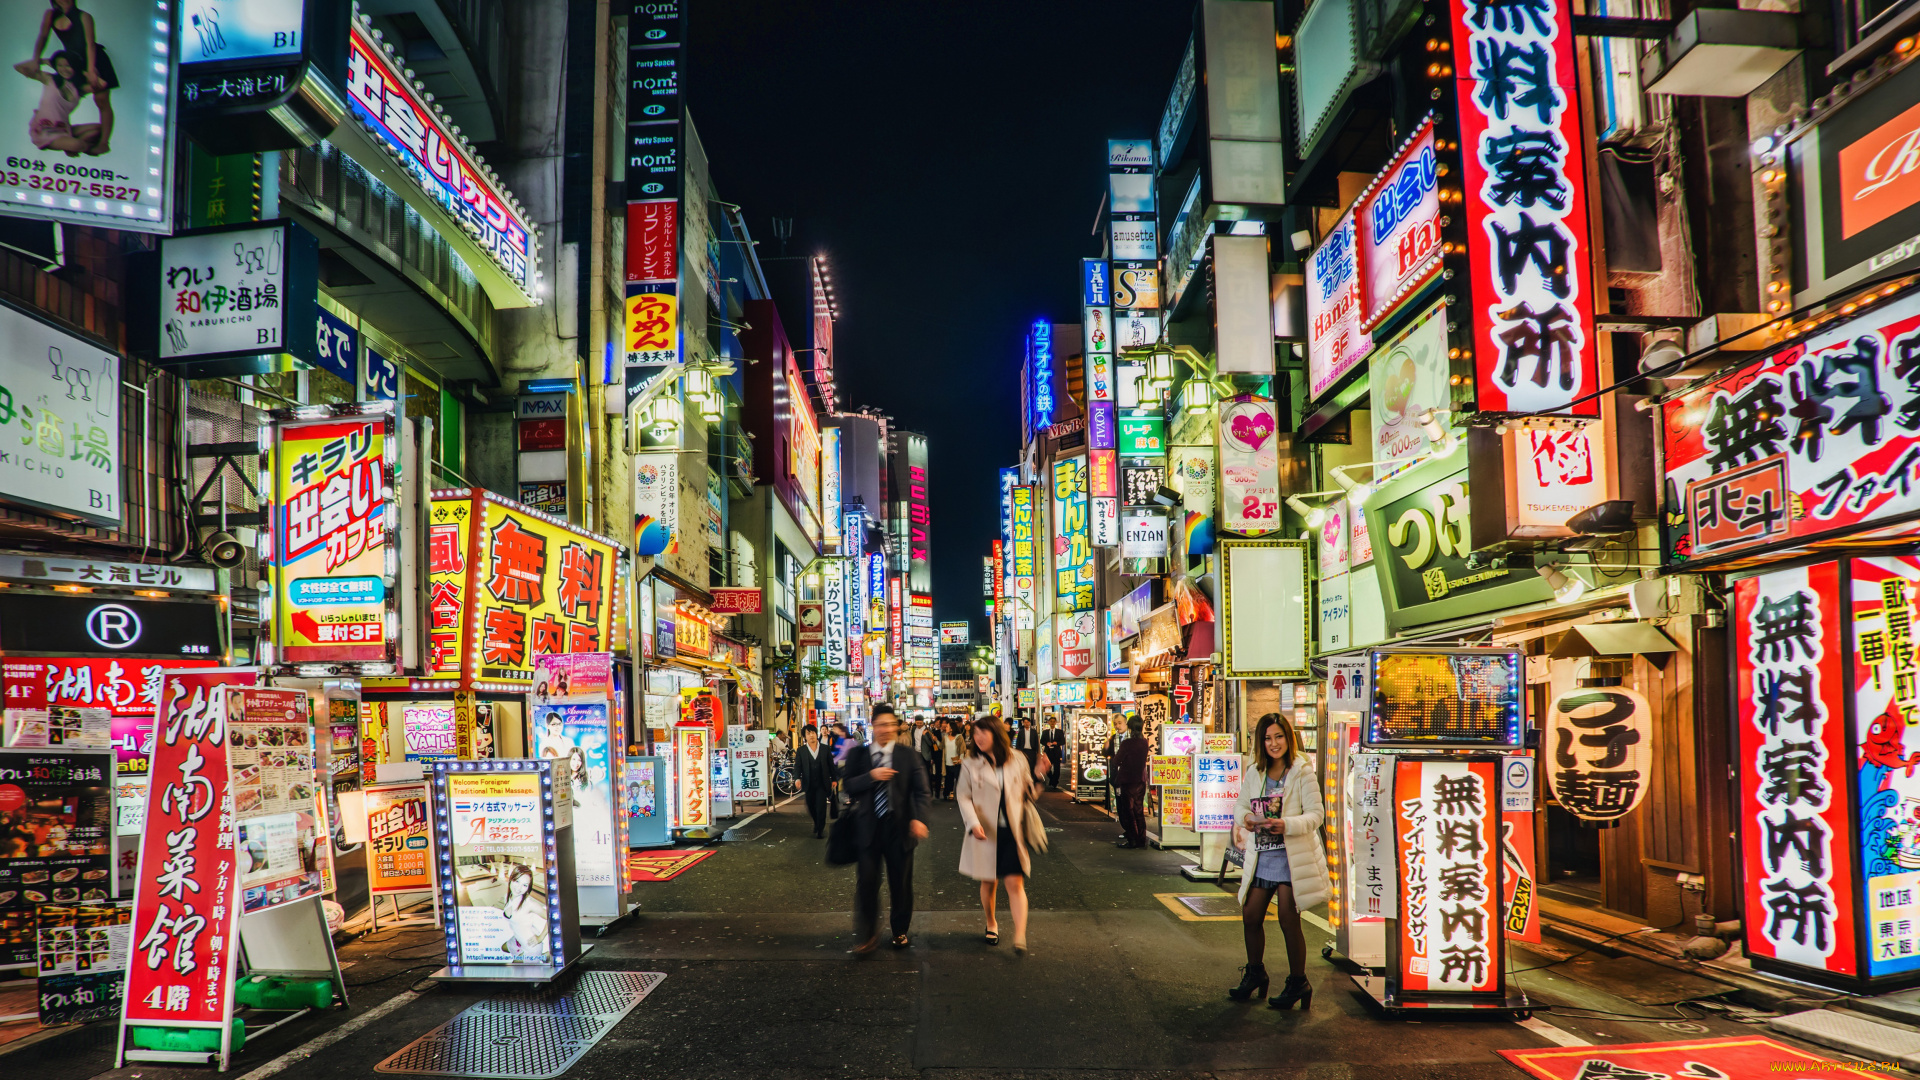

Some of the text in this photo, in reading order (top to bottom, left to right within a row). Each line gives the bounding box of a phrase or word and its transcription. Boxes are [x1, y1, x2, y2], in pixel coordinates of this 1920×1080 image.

[273, 31, 297, 48] B1
[650, 30, 661, 38] 5F
[636, 59, 675, 68] Party Space
[183, 74, 287, 99] 第一大滝ビル
[648, 106, 660, 114] 4F
[647, 184, 659, 193] 3F
[464, 177, 527, 255] カフェ
[644, 205, 657, 279] リフレッシュ
[663, 204, 672, 275] レンタルルーム ホステル
[1114, 229, 1154, 242] amusette
[166, 265, 215, 289] わい
[1091, 263, 1105, 303] JAビル
[1322, 259, 1354, 303] カフェ
[176, 284, 278, 314] 和伊酒場
[190, 316, 252, 328] KABUKICHO
[632, 297, 671, 350] らーめん
[256, 328, 278, 345] B1
[316, 315, 350, 368] なで
[1330, 328, 1349, 365] 3F
[627, 350, 675, 363] 博多天神
[366, 348, 397, 397] しこ
[1035, 321, 1053, 431] カラオケの鉄人
[628, 378, 648, 397] Party
[655, 429, 668, 437] B1
[1095, 407, 1105, 443] ROYAL
[1123, 424, 1153, 435] リーチ
[1135, 437, 1160, 449] 麻雀
[290, 423, 375, 486] キラリ
[88, 488, 113, 512] B1
[523, 485, 563, 506] 出会い
[550, 496, 566, 505] カフェ
[287, 458, 383, 554] 出会い
[1242, 495, 1278, 519] 2F
[1527, 503, 1577, 512] TSUKEMEN
[1697, 484, 1786, 536] 北斗
[1013, 487, 1033, 576] まんが喫茶
[1055, 459, 1095, 609] まんが喫茶
[1126, 530, 1164, 542] ENZAN
[327, 515, 384, 575] カフェ
[1363, 548, 1372, 560] 3F
[1339, 549, 1349, 563] 2F
[23, 558, 183, 586] 一大滝ビル
[487, 515, 604, 621] 無料
[300, 580, 373, 594] 女性は全て無料!
[708, 592, 761, 609] 料案内所
[320, 613, 381, 622] いらっしゃいませ！
[1322, 604, 1349, 622] アイランド
[317, 624, 381, 642] 受付3F
[1061, 631, 1077, 641] 24H
[1331, 635, 1340, 643] B1
[182, 645, 209, 654] 会員制
[1855, 607, 1889, 693] 一番！
[1882, 577, 1920, 727] 歌舞伎町で
[1064, 653, 1089, 666] 受付入口
[5, 684, 36, 698] 4F
[45, 661, 163, 708] 湖南菜
[563, 705, 592, 715] Aroma
[564, 715, 607, 725] Relaxation
[1198, 758, 1239, 771] 出会い
[1555, 692, 1641, 818] つけ麺
[686, 732, 703, 823] 風俗・キャバクラ
[740, 759, 760, 790] つけ麺
[1160, 768, 1181, 780] ¥500
[1198, 773, 1239, 783] カフェ 3F
[1753, 589, 1834, 953] 無料案内所
[480, 779, 511, 787] Foreigner
[504, 787, 534, 795] Massage.
[1200, 789, 1239, 799] Hanako
[472, 802, 536, 812] タイ古式マッサージ
[139, 677, 228, 977] 湖南菜館
[371, 800, 423, 840] 出会い
[406, 821, 428, 837] カフェ
[372, 836, 404, 853] キラリ
[1402, 800, 1430, 954] ファイナルアンサー
[1432, 774, 1487, 985] 無料案内所
[1879, 887, 1913, 909] 地域
[1879, 918, 1913, 938] 東京
[15, 954, 31, 962] TEL
[1880, 938, 1913, 959] 大阪
[141, 984, 192, 1013] 4階
